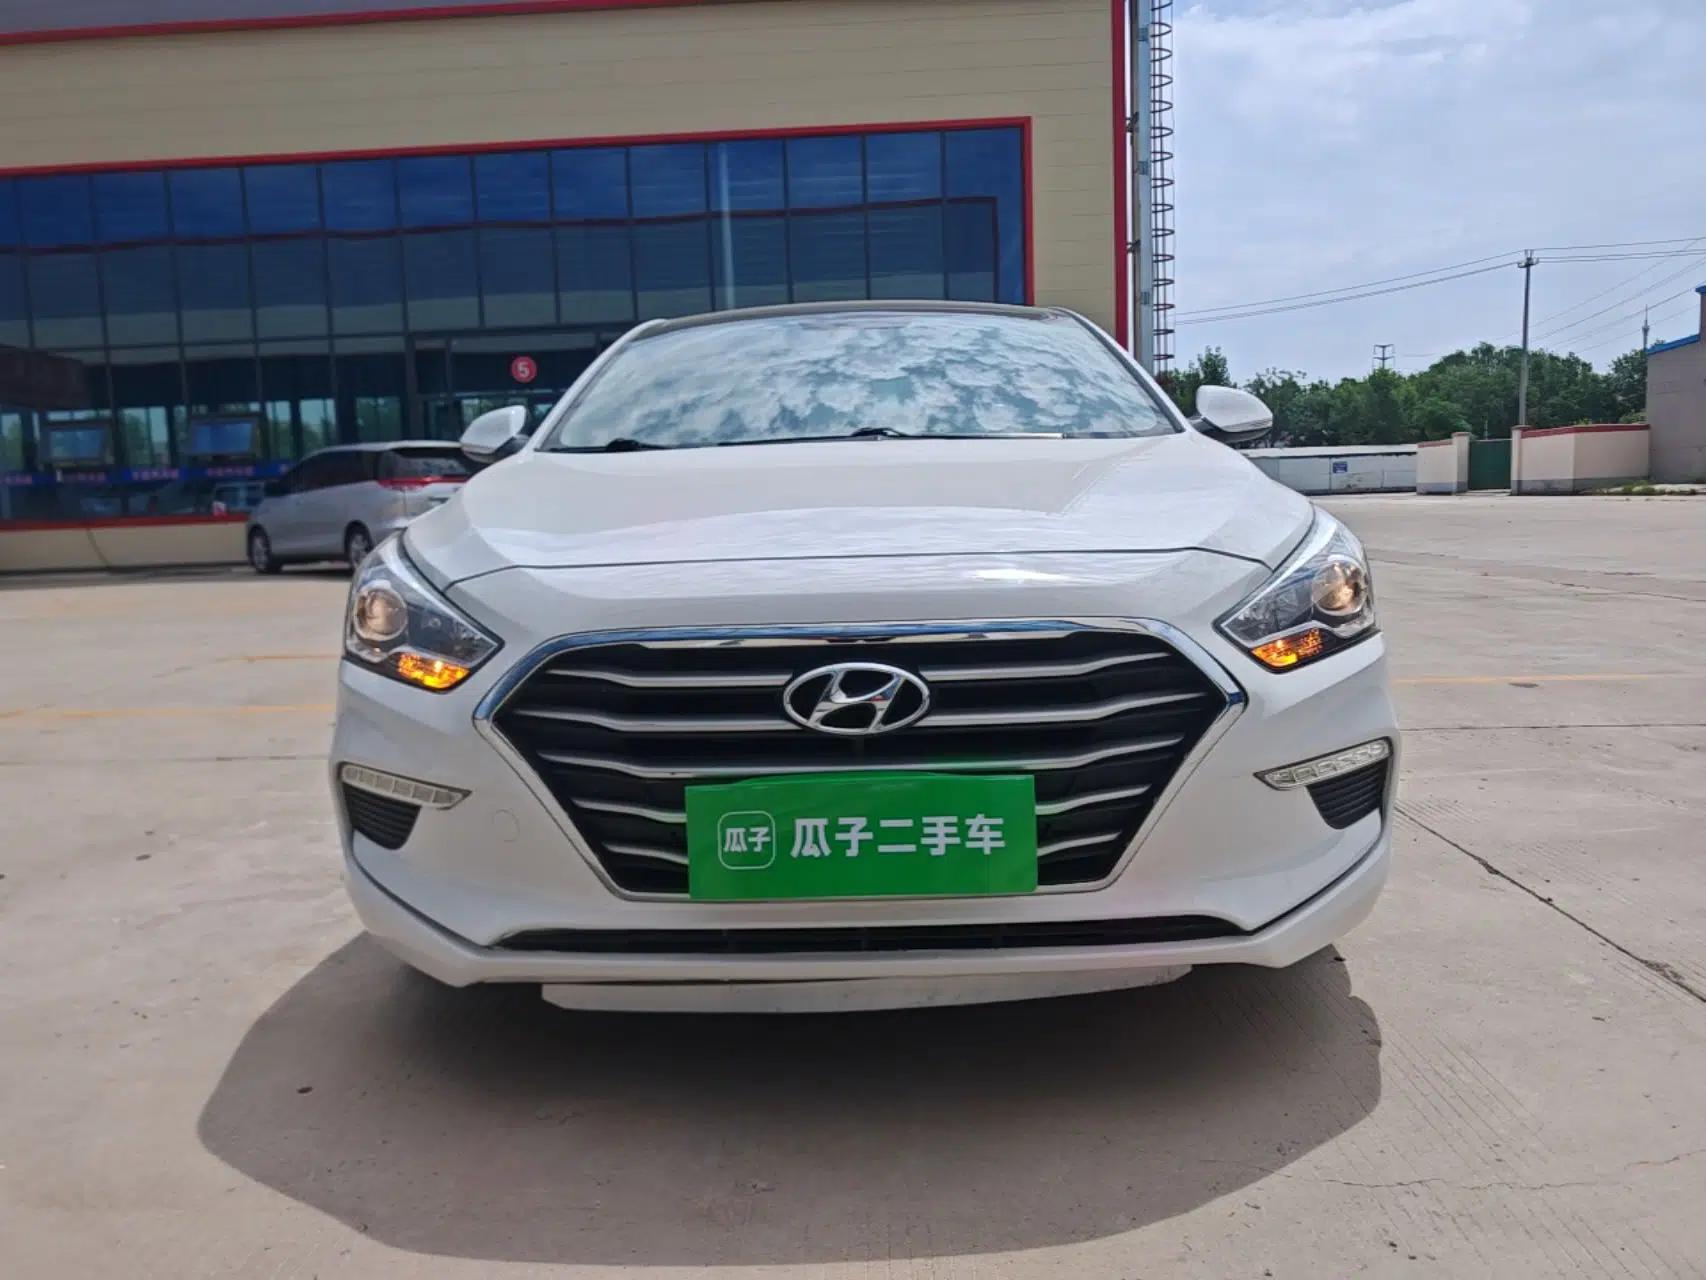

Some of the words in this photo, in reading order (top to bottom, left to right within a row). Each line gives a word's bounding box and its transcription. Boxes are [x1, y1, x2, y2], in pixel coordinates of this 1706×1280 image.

[517, 361, 530, 378] 5
[724, 827, 771, 853] 瓜子
[790, 813, 1006, 858] 瓜子二手车
